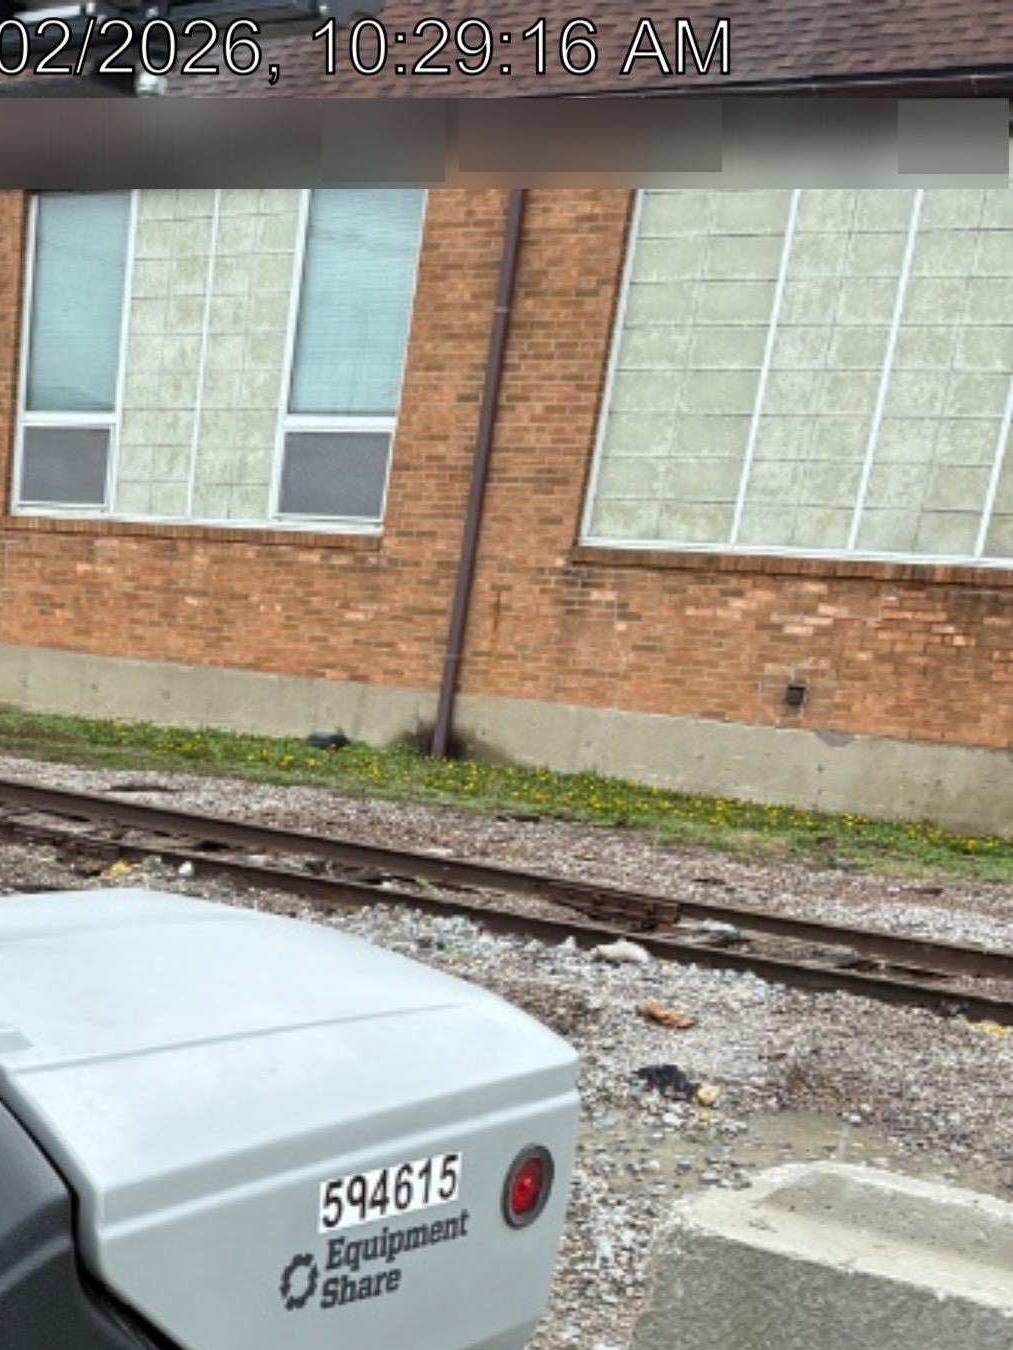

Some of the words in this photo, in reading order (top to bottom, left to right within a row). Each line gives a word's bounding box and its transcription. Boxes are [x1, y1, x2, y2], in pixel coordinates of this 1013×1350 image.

[322, 1154, 459, 1229] 594615
[325, 1208, 470, 1272] Equipment
[320, 1269, 403, 1310] Share
